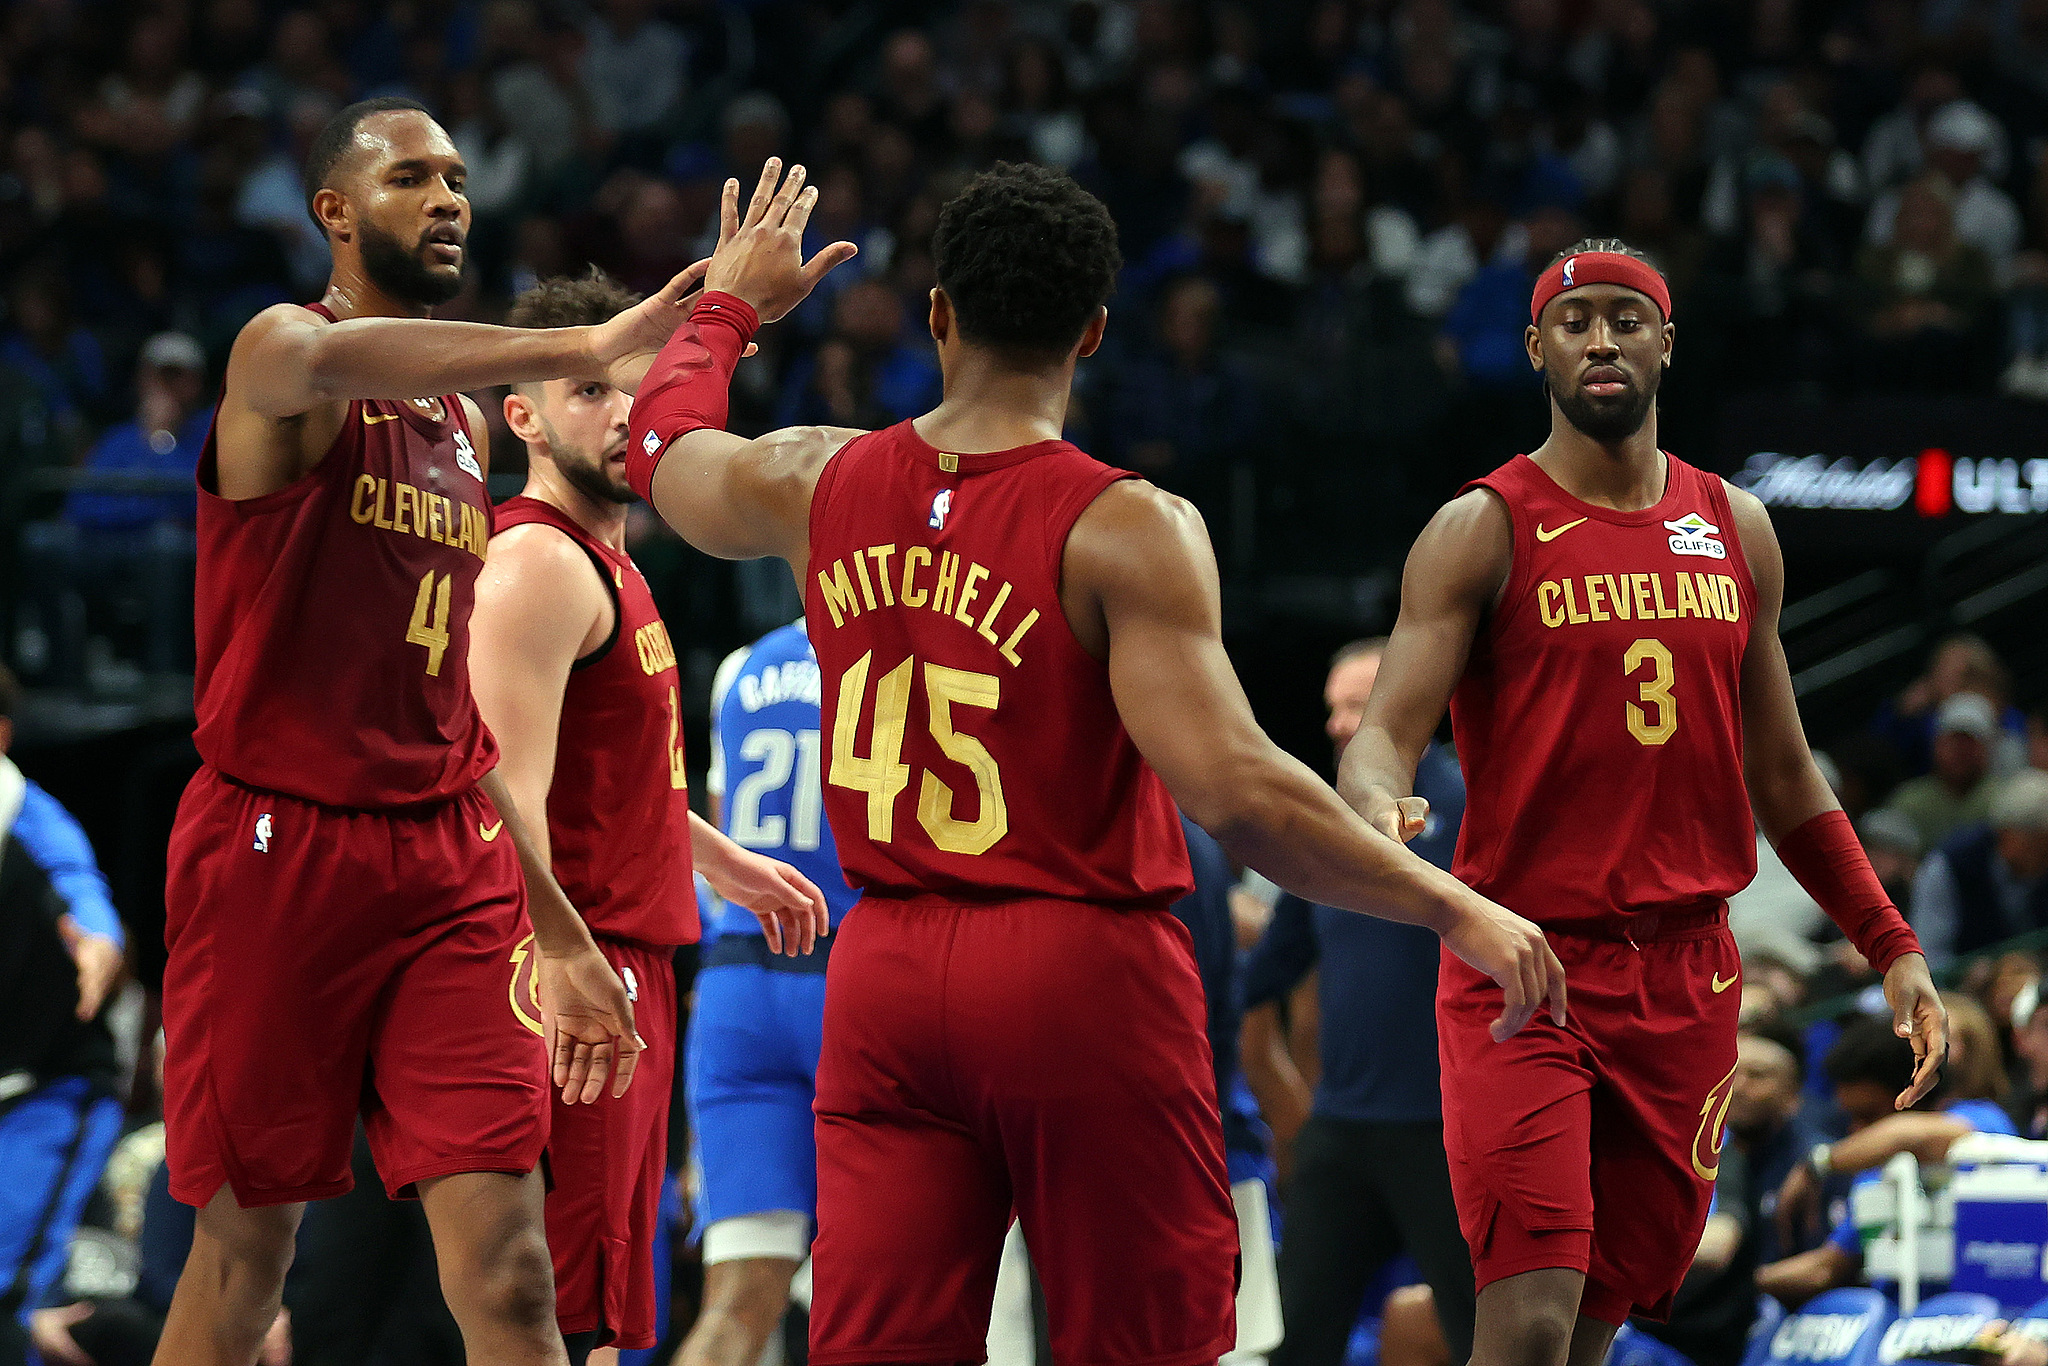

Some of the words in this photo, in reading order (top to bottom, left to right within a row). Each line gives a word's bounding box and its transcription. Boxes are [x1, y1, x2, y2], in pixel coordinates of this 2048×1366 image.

[351, 473, 487, 563] CLEVELAN
[1671, 540, 1723, 555] CLIFFS
[406, 569, 451, 677] 4
[818, 543, 1040, 668] MITCHELL
[1538, 571, 1740, 638] CLEVELAND
[1624, 638, 1677, 746] 3
[729, 728, 821, 852] 21
[829, 649, 1008, 856] 45
